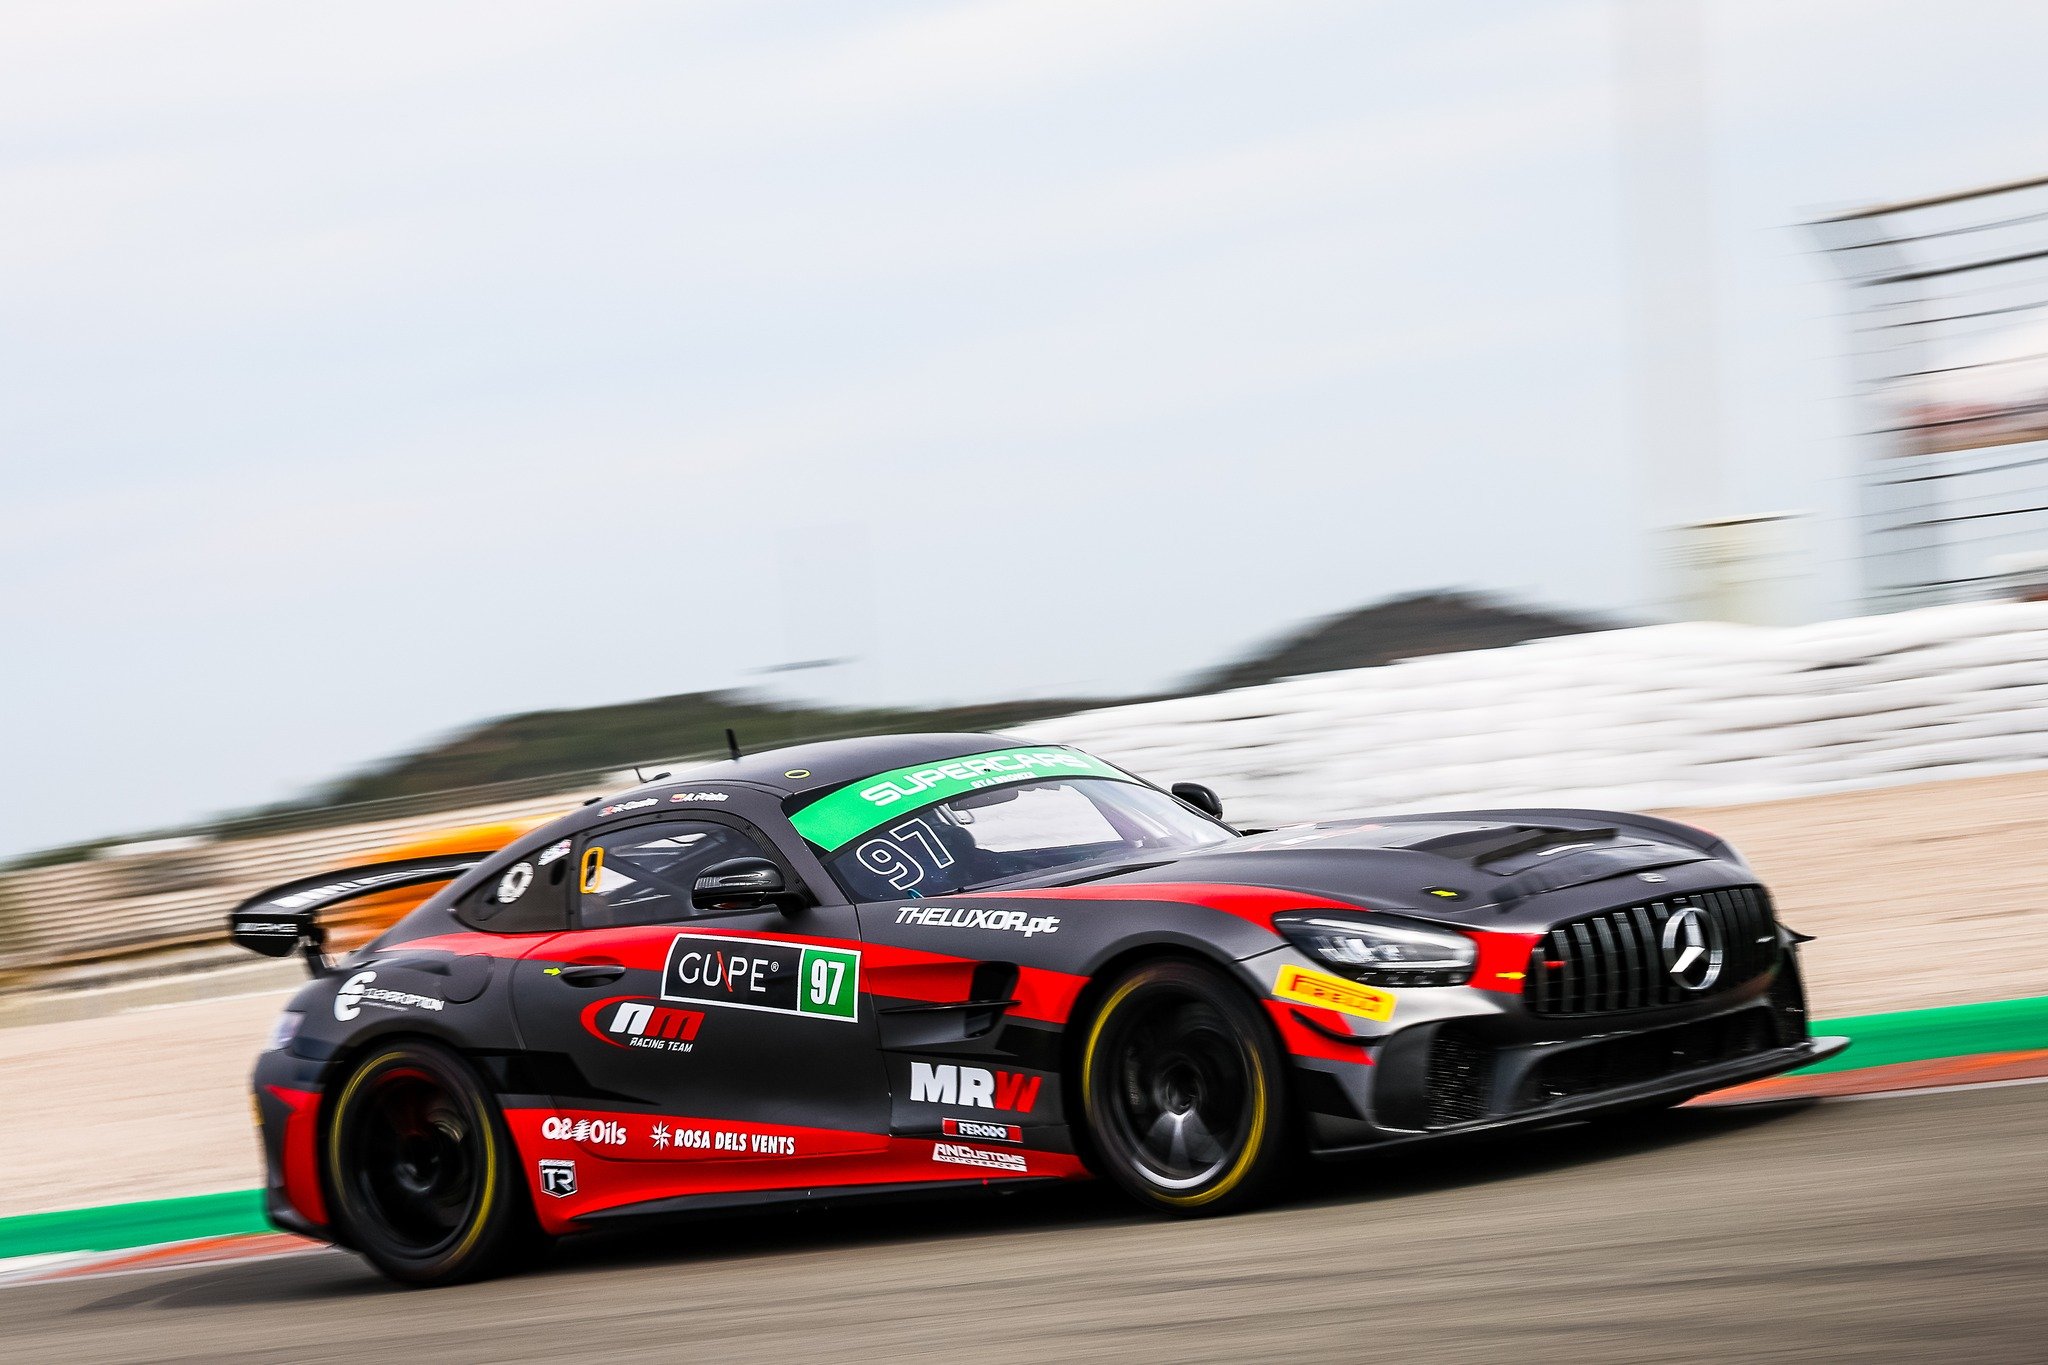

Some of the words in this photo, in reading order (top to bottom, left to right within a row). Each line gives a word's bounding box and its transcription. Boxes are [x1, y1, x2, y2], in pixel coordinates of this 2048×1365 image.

[859, 752, 1091, 806] SUPERCARS
[855, 817, 955, 891] 97
[810, 959, 846, 1006] 97
[629, 1037, 664, 1050] RACING
[667, 1041, 693, 1053] TEAM
[910, 1061, 1042, 1113] MRW
[590, 1120, 627, 1146] Oils
[674, 1129, 711, 1149] ROSA
[714, 1132, 747, 1151] DELS
[751, 1135, 795, 1155] VENTS
[958, 1122, 1007, 1139] FERODO
[542, 1168, 574, 1191] TR
